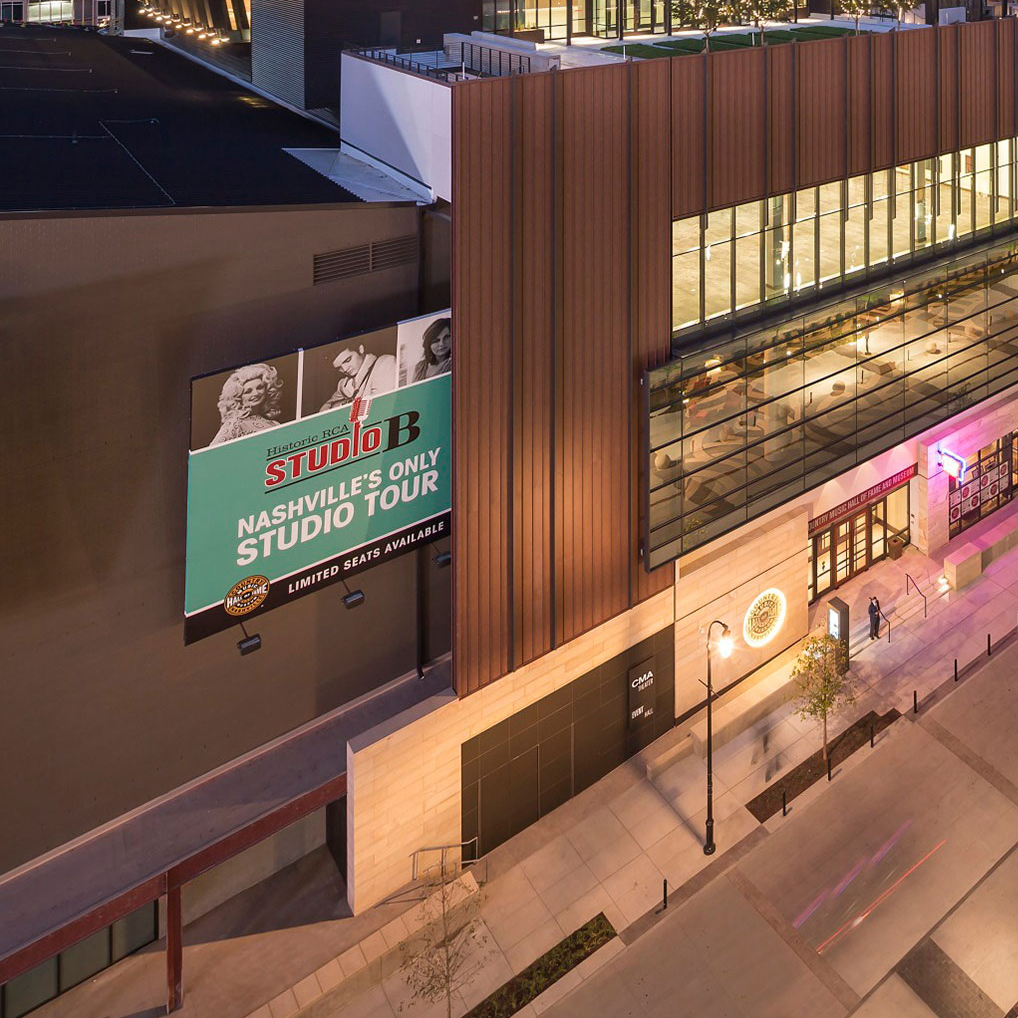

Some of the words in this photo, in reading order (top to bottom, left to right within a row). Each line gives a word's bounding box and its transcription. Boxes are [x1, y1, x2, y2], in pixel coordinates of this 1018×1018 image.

[266, 434, 319, 457] Historic
[322, 424, 350, 439] RCA
[382, 410, 421, 453] B
[237, 469, 383, 539] NASHVILLE'S
[388, 447, 442, 481] ONLY
[236, 501, 355, 567] STUDIO
[364, 469, 440, 517] TOUR
[808, 514, 829, 531] OUNTRY
[288, 565, 340, 594] LIMITED
[343, 547, 381, 571] SEATS
[384, 521, 445, 555] AVAILABLE
[631, 671, 653, 688] CMA
